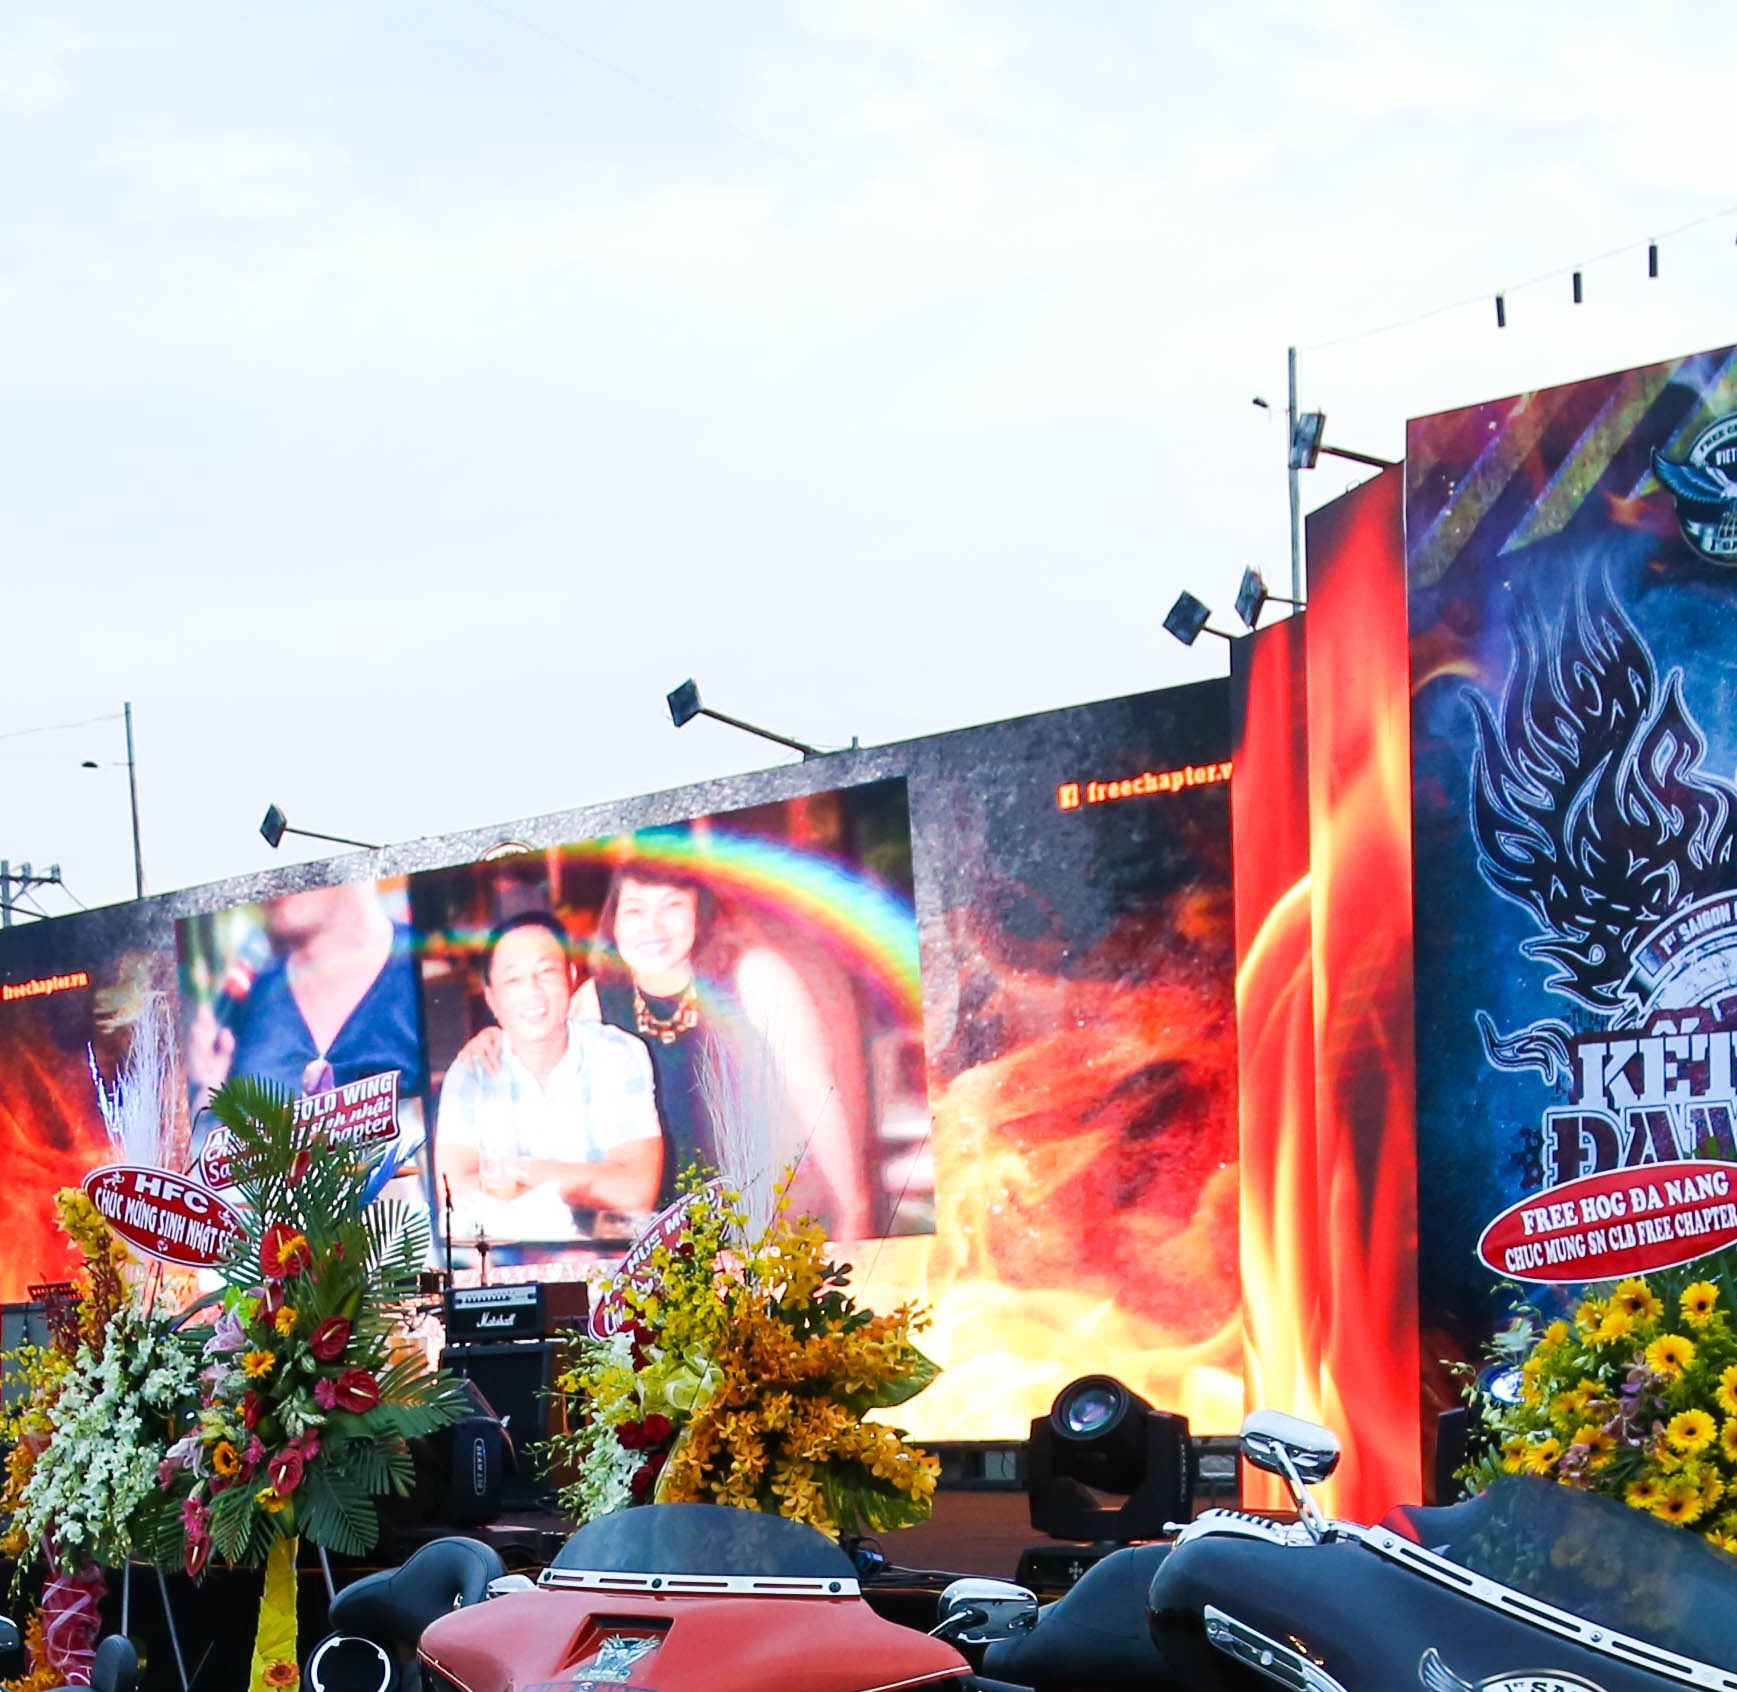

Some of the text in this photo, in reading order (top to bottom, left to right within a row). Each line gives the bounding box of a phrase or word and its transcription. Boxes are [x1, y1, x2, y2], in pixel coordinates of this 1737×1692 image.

[1678, 903, 1732, 943] SAIGON
[342, 1075, 394, 1108] WING
[134, 1172, 210, 1214] HFC
[1520, 1203, 1579, 1236] FREE
[1581, 1190, 1628, 1222] HOG
[1665, 1170, 1730, 1206] NANG
[157, 1208, 188, 1244] SINH
[1504, 1245, 1545, 1273] CHUC
[1546, 1234, 1587, 1264] MUNG
[1586, 1230, 1608, 1256] SN
[1608, 1224, 1636, 1252] CLB
[1637, 1216, 1672, 1246] FREE
[475, 1311, 517, 1328] Marshall
